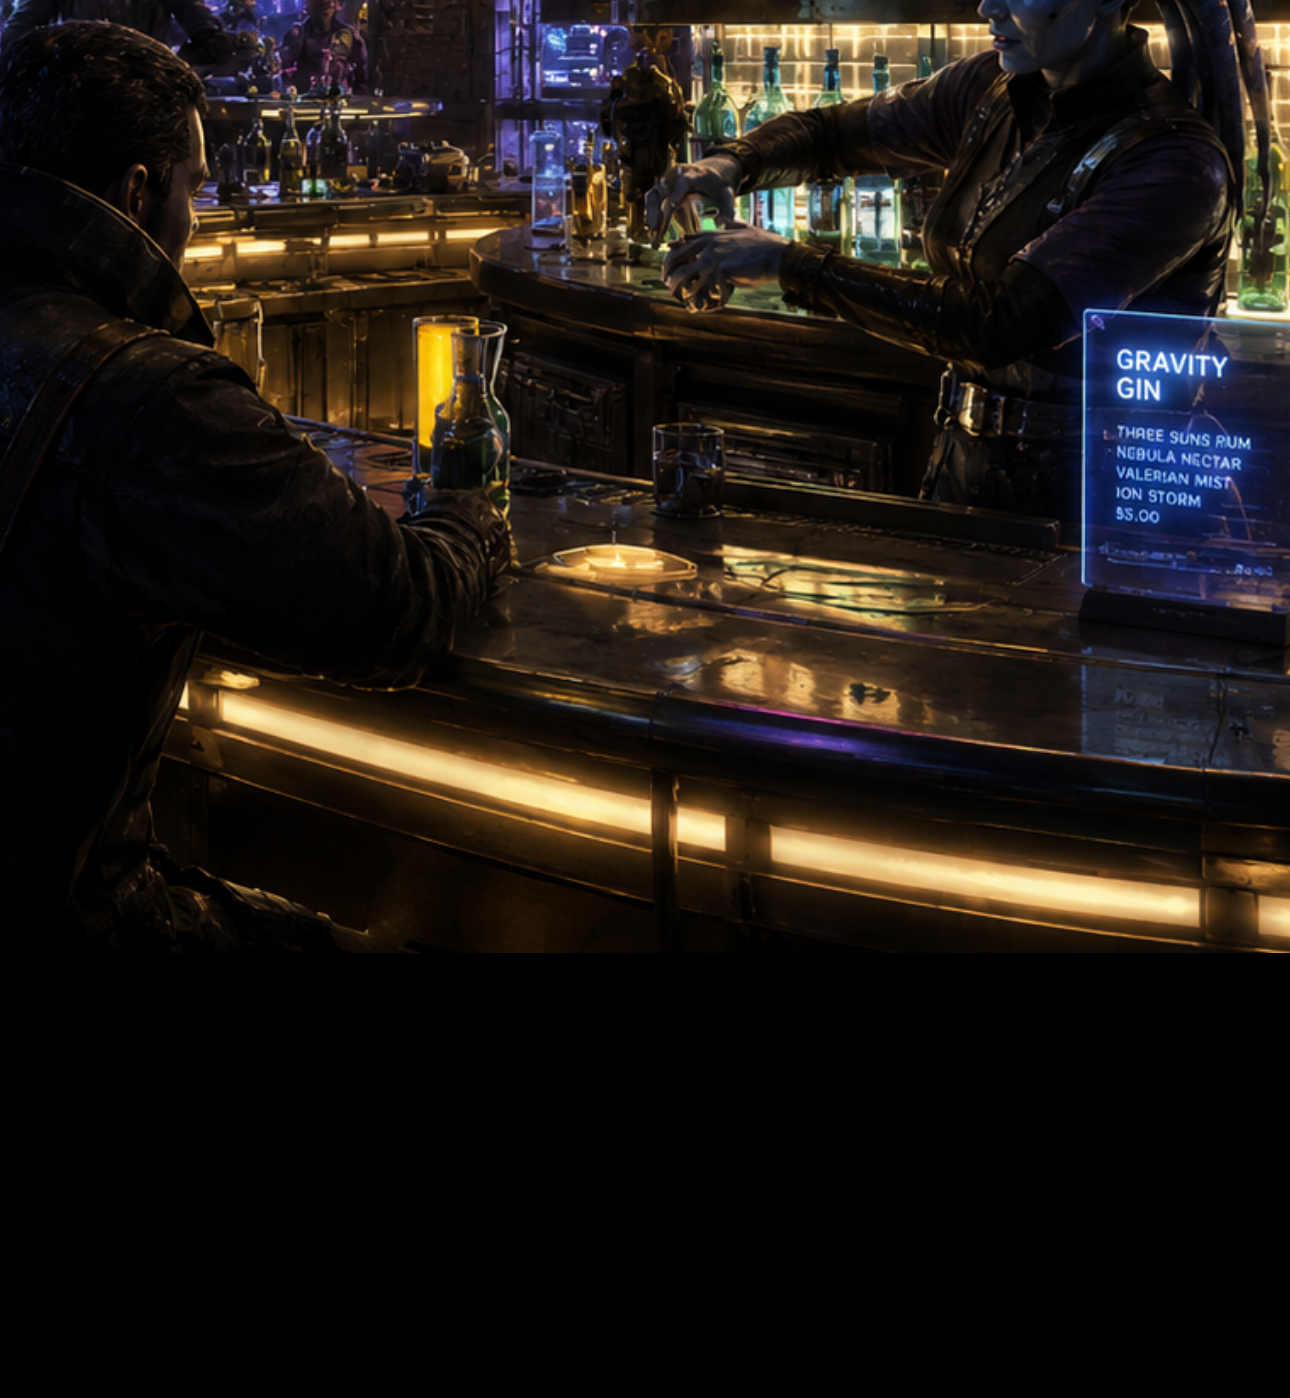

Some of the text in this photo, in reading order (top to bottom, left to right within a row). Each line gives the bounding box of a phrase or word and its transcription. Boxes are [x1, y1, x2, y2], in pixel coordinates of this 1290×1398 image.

[1116, 349, 1229, 378] GRAVITY
[1116, 377, 1161, 401] GIN
[1117, 424, 1252, 451] THREE SUNS RUM
[1116, 445, 1243, 472] NEBULA NECTAR
[1115, 465, 1231, 491] VALERIAN MIST
[1115, 486, 1202, 509] ION STORM
